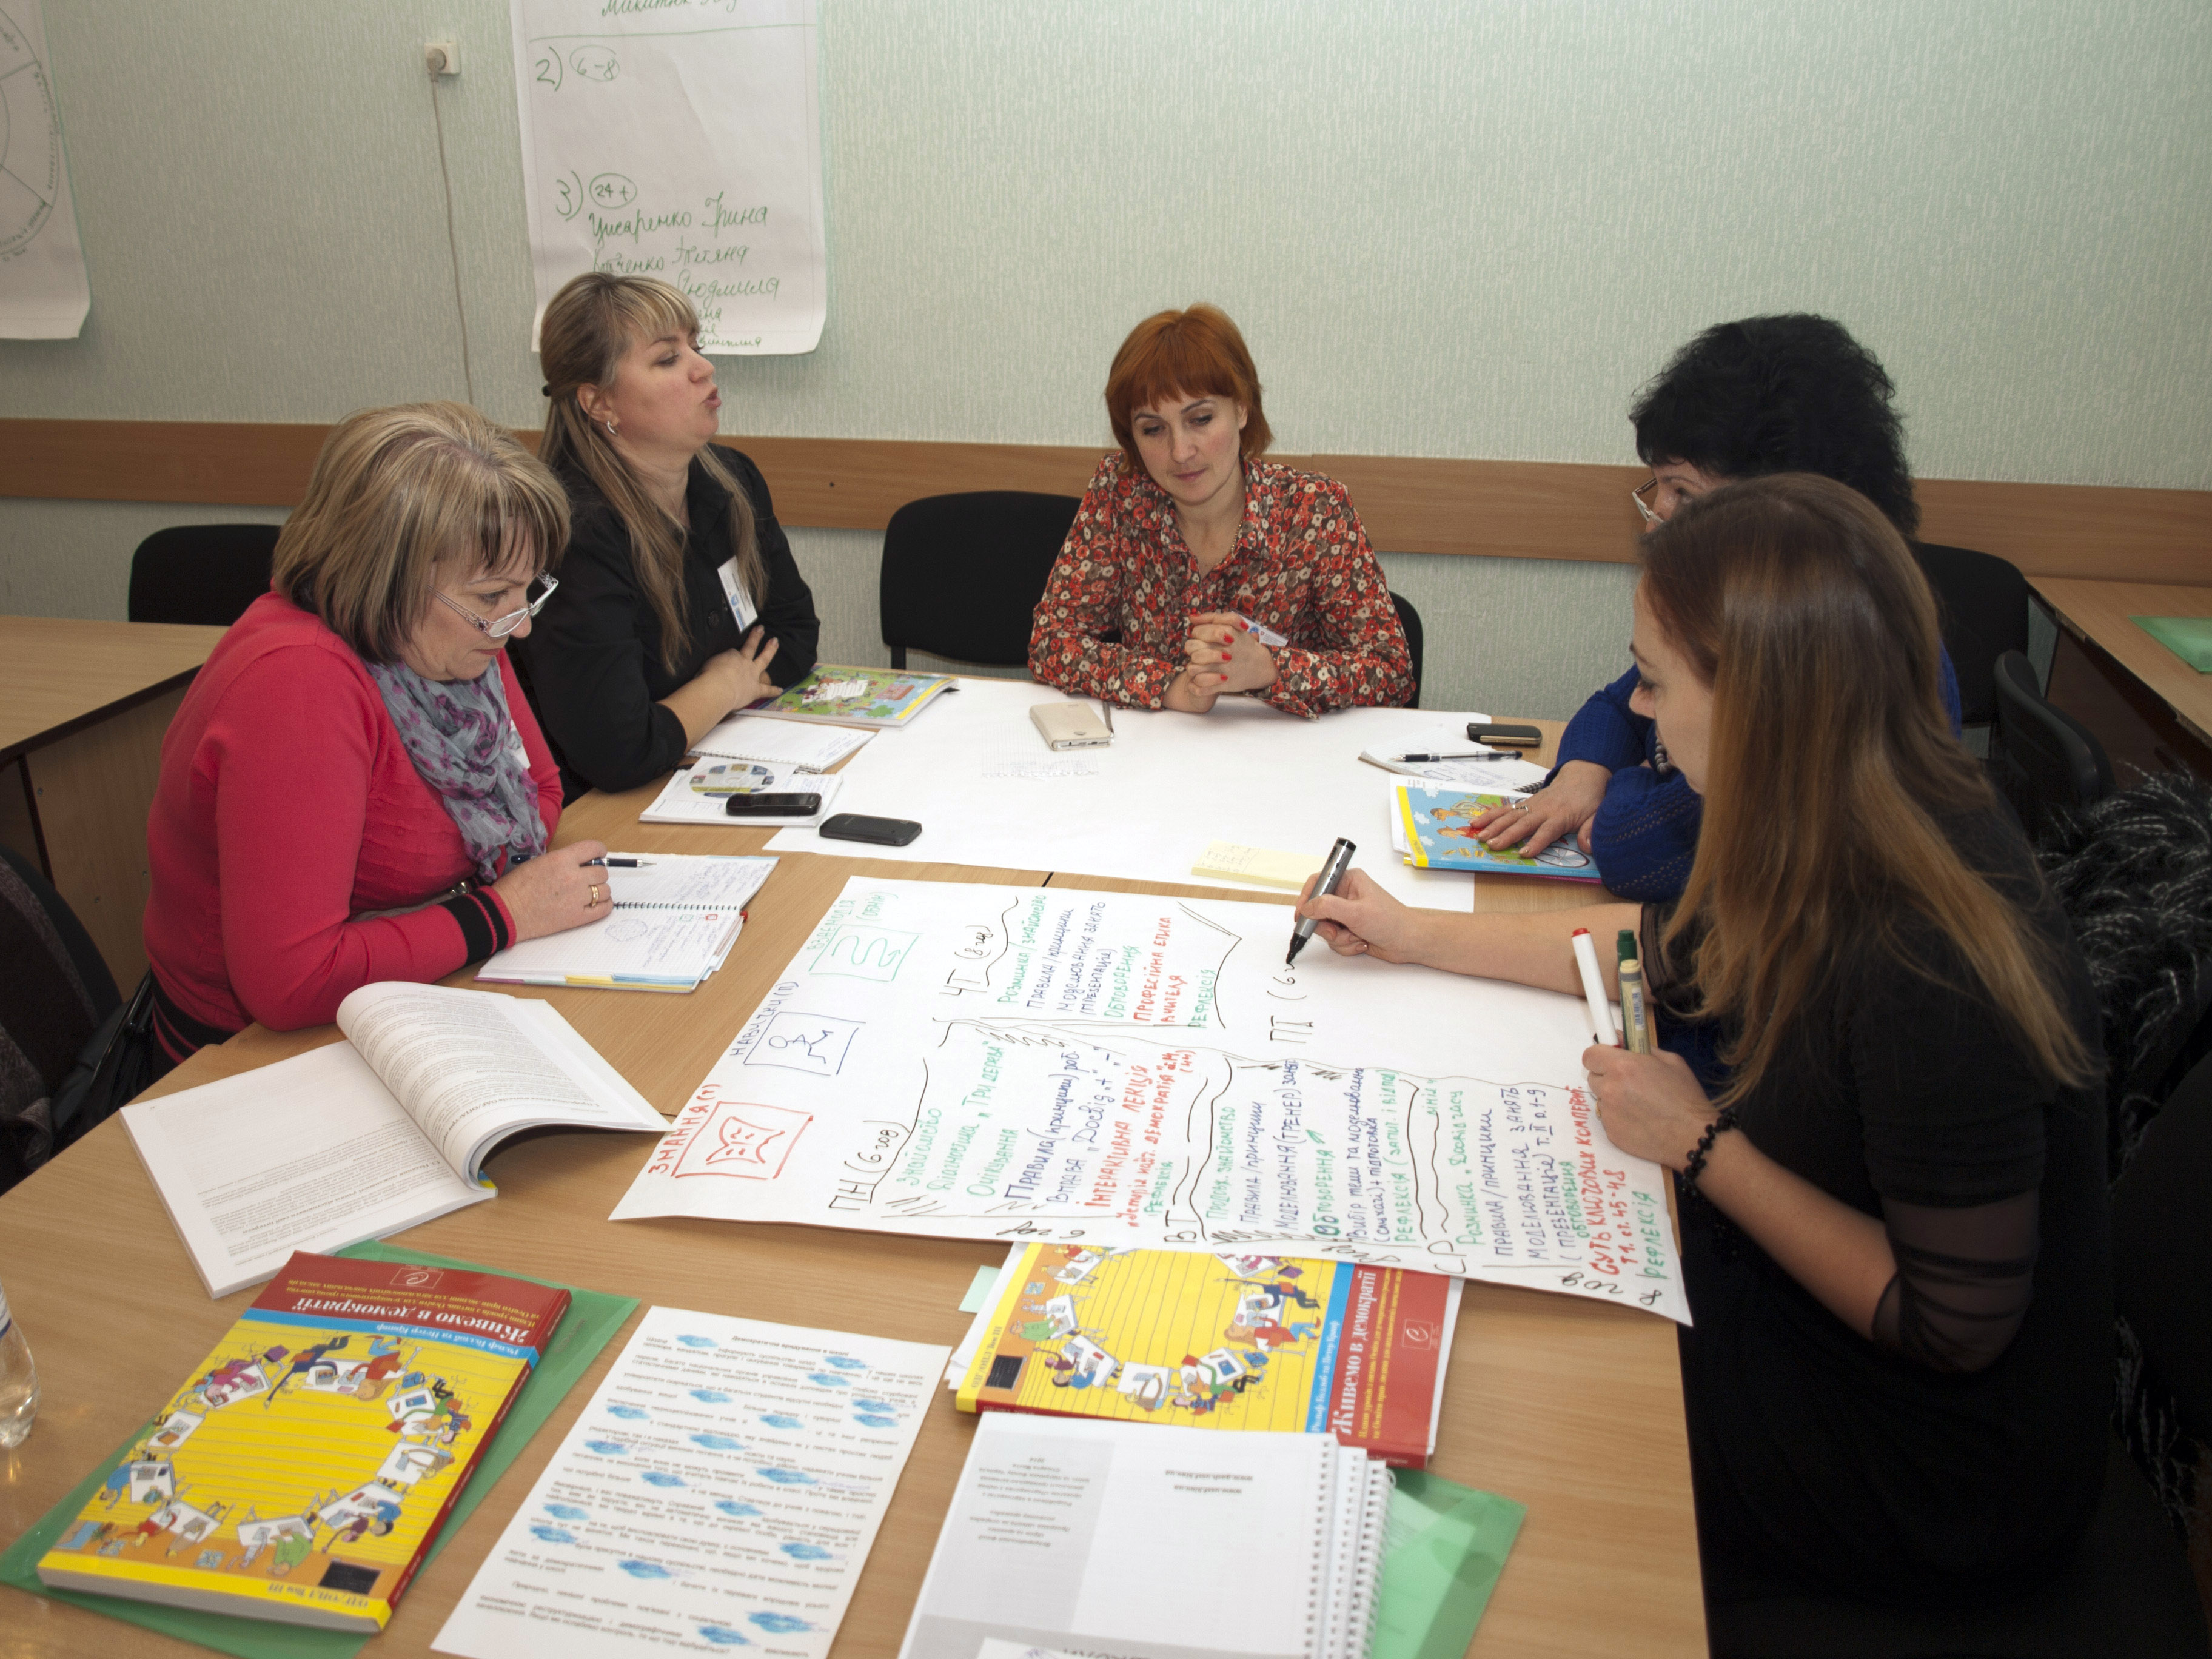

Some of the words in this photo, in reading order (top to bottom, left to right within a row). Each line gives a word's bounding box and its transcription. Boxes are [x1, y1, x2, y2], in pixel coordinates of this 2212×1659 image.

[939, 968, 990, 997] ЧТ
[1133, 952, 1164, 1021] ПРОФЕСІЙНА
[1153, 917, 1171, 947] ЕТИКА
[828, 1179, 879, 1211] ПН
[1163, 1210, 1202, 1246] ВТ
[1425, 1237, 1470, 1276] СР
[1583, 1228, 1620, 1276] СУТЬ
[289, 1296, 416, 1319] демократії
[414, 1310, 432, 1320] в
[1350, 1269, 1378, 1341] демократії
[431, 1312, 531, 1344] Живемо
[1350, 1342, 1363, 1352] в
[1328, 1355, 1361, 1436] Живемо
